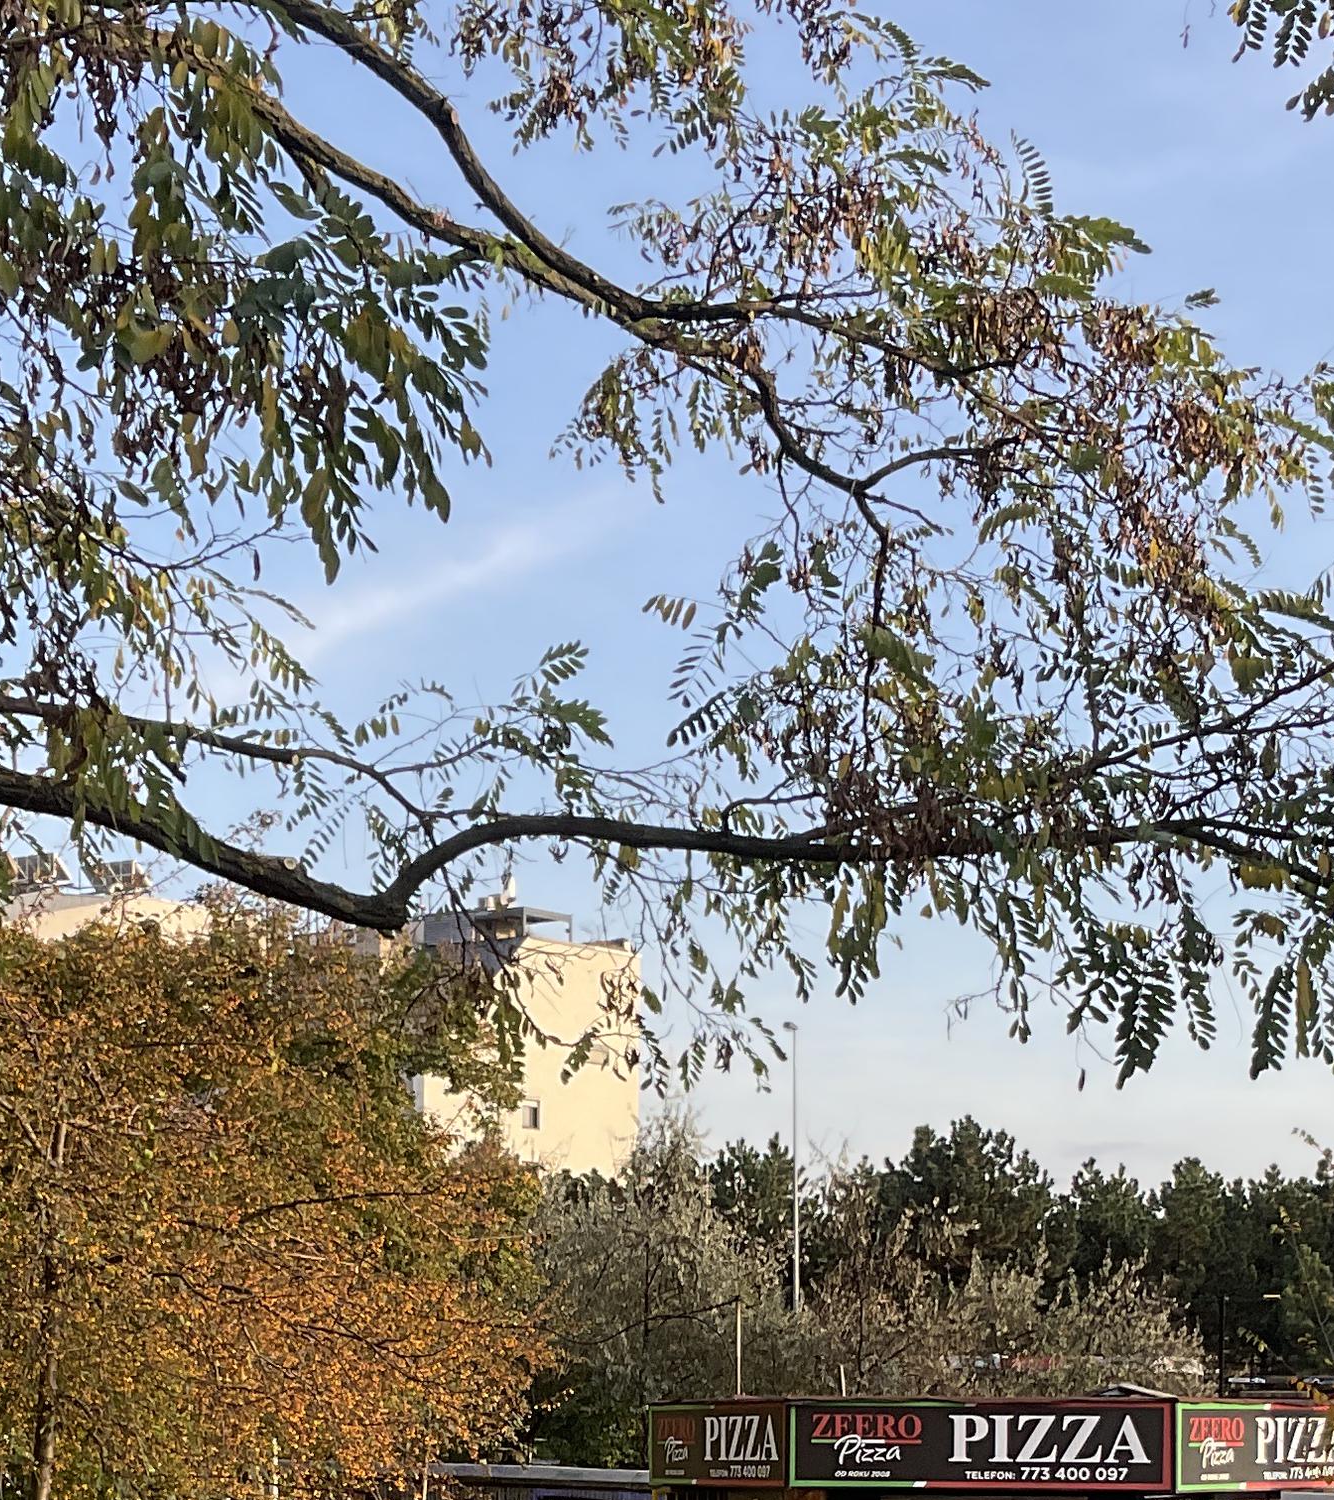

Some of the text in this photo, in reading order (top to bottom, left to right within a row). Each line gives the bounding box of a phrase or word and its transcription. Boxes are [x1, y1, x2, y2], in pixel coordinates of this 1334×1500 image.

[664, 1436, 689, 1464] Pizza
[704, 1414, 779, 1461] PIZZA
[833, 1434, 901, 1465] Pizza
[948, 1414, 1151, 1463] PIZZA
[1199, 1437, 1235, 1469] Pizza
[834, 1470, 847, 1478] OD
[847, 1470, 870, 1478] ROKU
[965, 1466, 1129, 1481] TELEFON: 773 400 097
